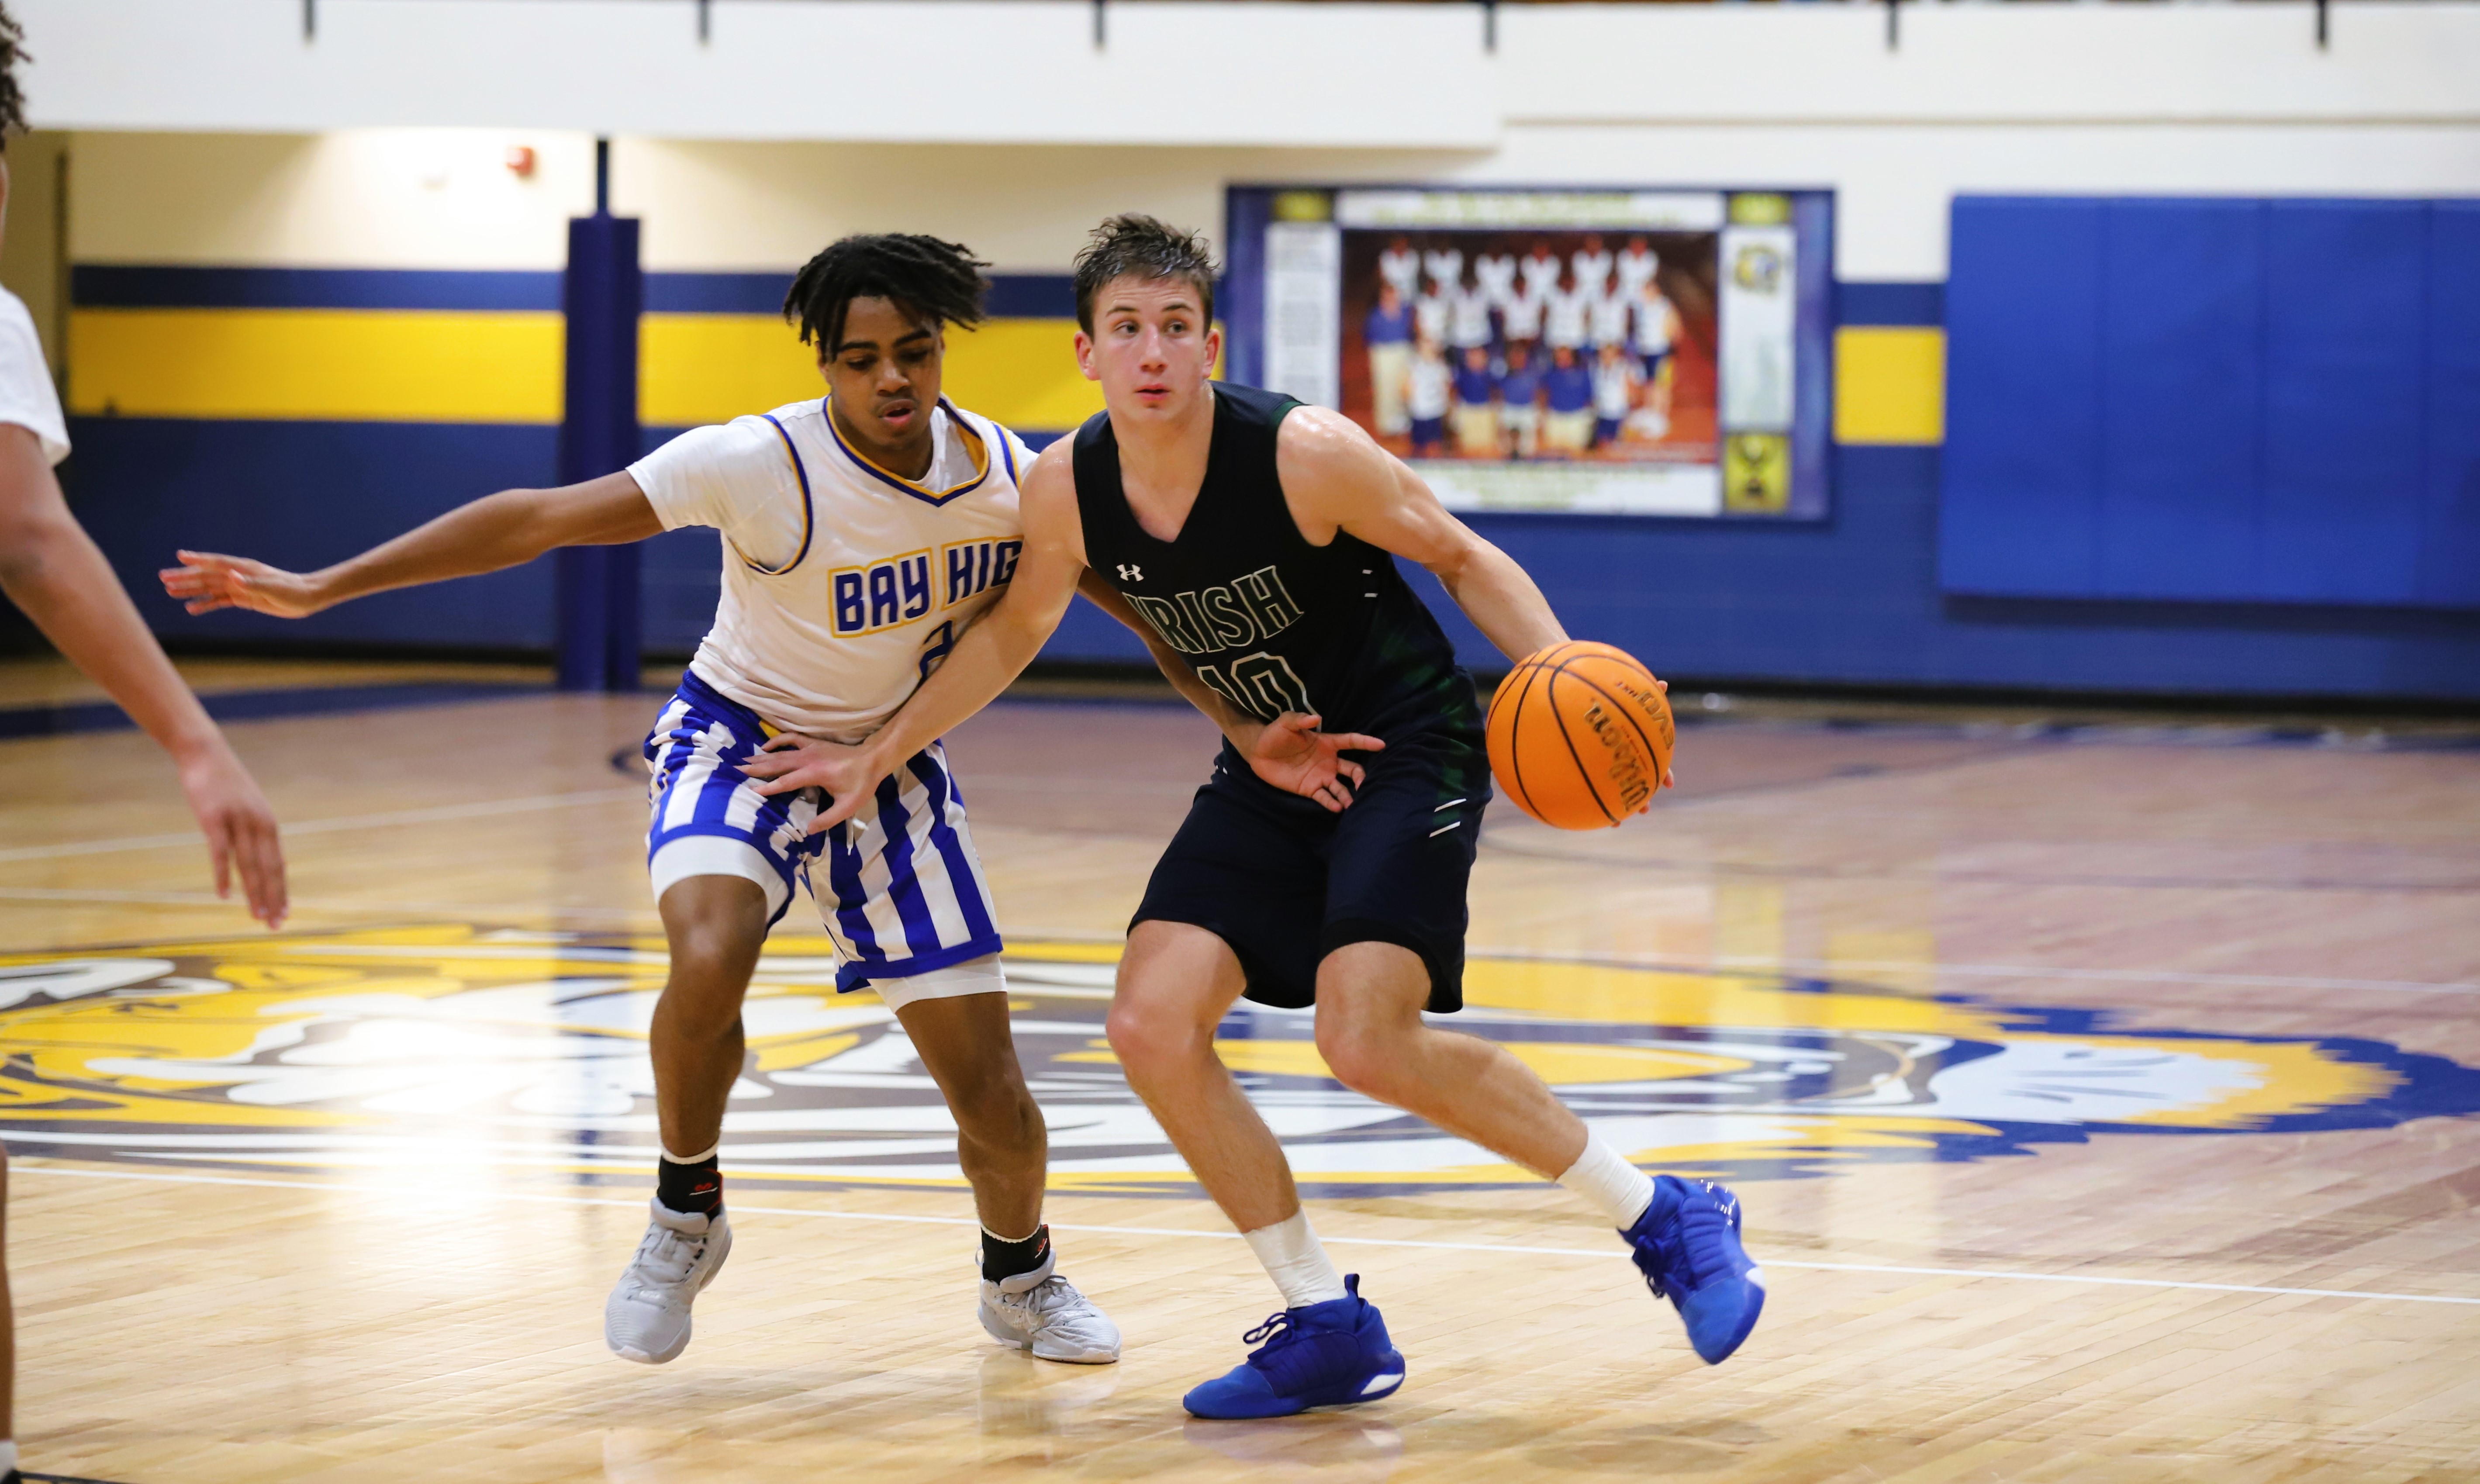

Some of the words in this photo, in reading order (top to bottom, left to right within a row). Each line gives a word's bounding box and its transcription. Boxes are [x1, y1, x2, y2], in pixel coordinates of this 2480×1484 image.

[832, 553, 931, 633] BAY
[946, 539, 1024, 605] HIG
[1122, 565, 1305, 654] IRISH
[919, 619, 954, 682] 2
[1196, 651, 1323, 733] 10
[1584, 702, 1650, 812] Wilson
